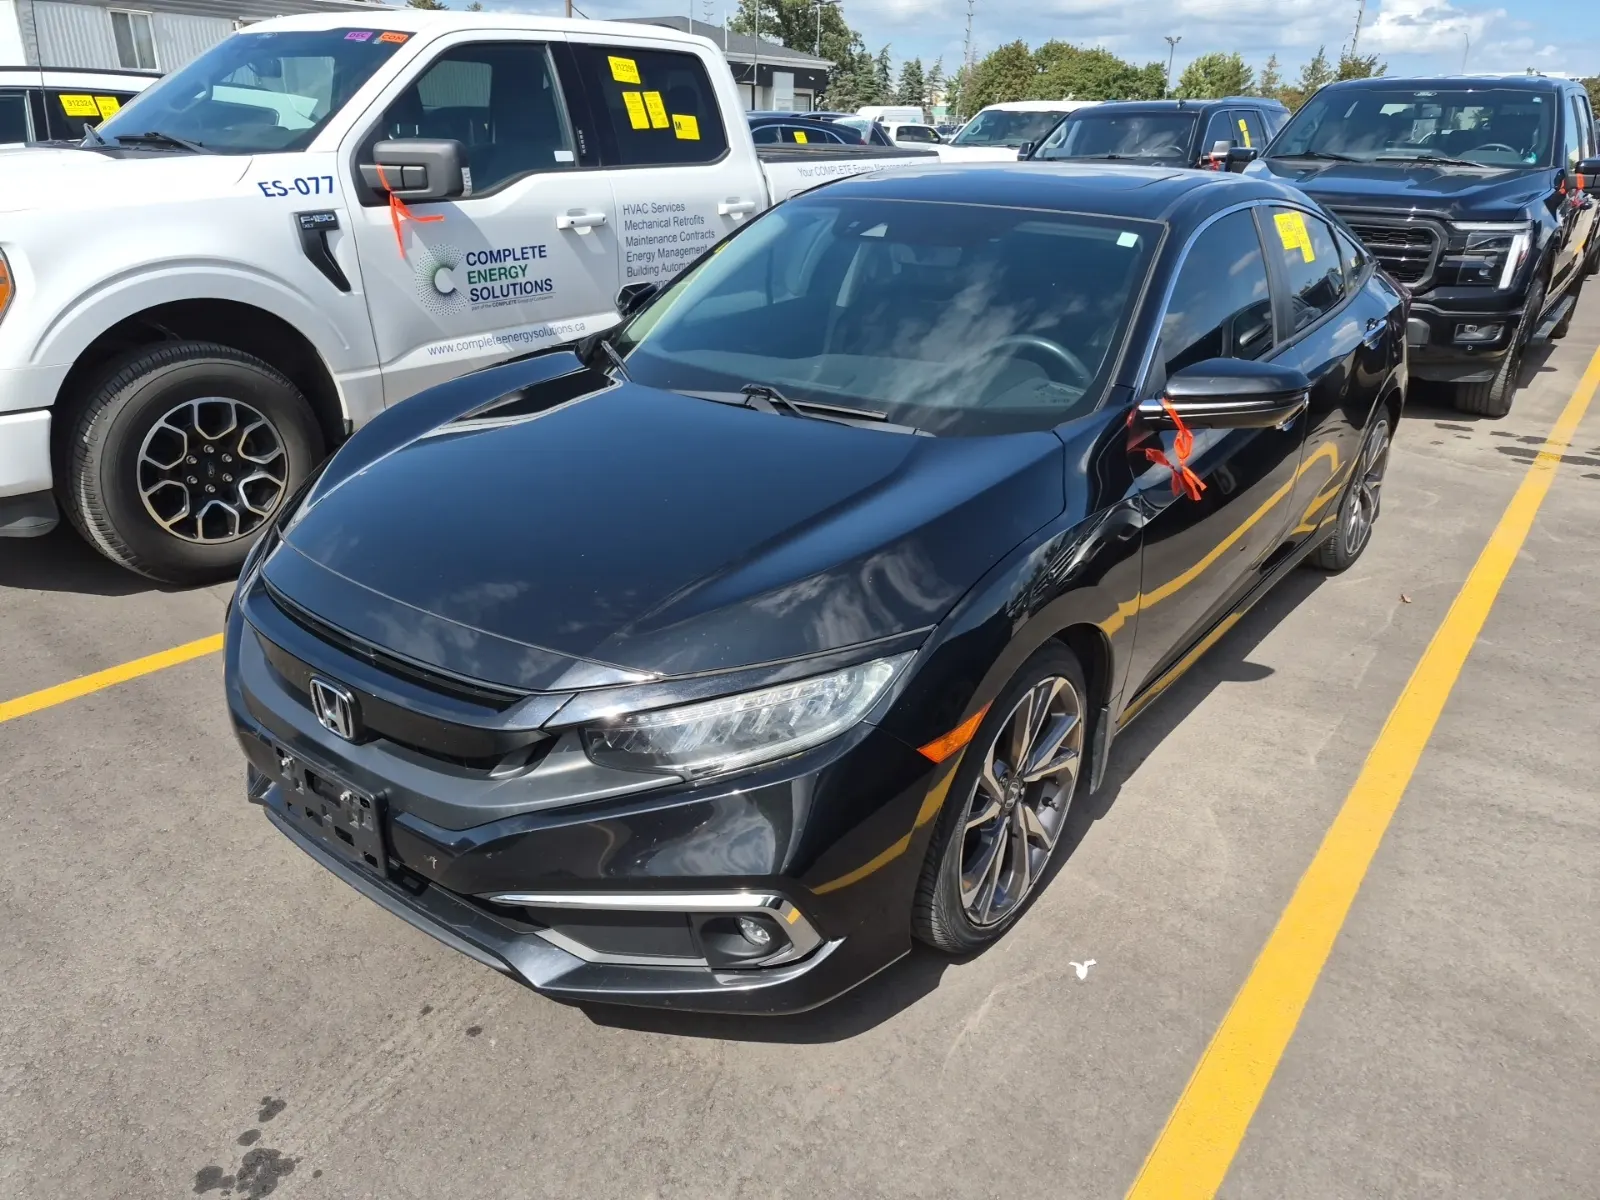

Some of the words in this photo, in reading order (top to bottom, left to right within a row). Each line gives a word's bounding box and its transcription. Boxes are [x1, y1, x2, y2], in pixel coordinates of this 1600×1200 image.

[797, 167, 814, 178] Your
[814, 164, 852, 176] COMPLETE
[257, 175, 333, 198] ES-077
[622, 203, 649, 216] HVAC
[651, 202, 686, 214] Services
[624, 217, 671, 231] Mechanical
[672, 214, 705, 227] Retrofits
[625, 234, 678, 248] Maintenance
[679, 229, 716, 242] Contracts
[465, 244, 547, 267] COMPLETE
[626, 250, 656, 263] Energy
[657, 244, 708, 259] Management
[466, 263, 528, 285] ENERGY
[626, 265, 660, 278] Building
[660, 259, 694, 273] Autom
[469, 277, 554, 303] SOLUTIONS
[492, 299, 517, 308] COMPLETE
[426, 321, 586, 356] www.completeenergysolutions.ca
